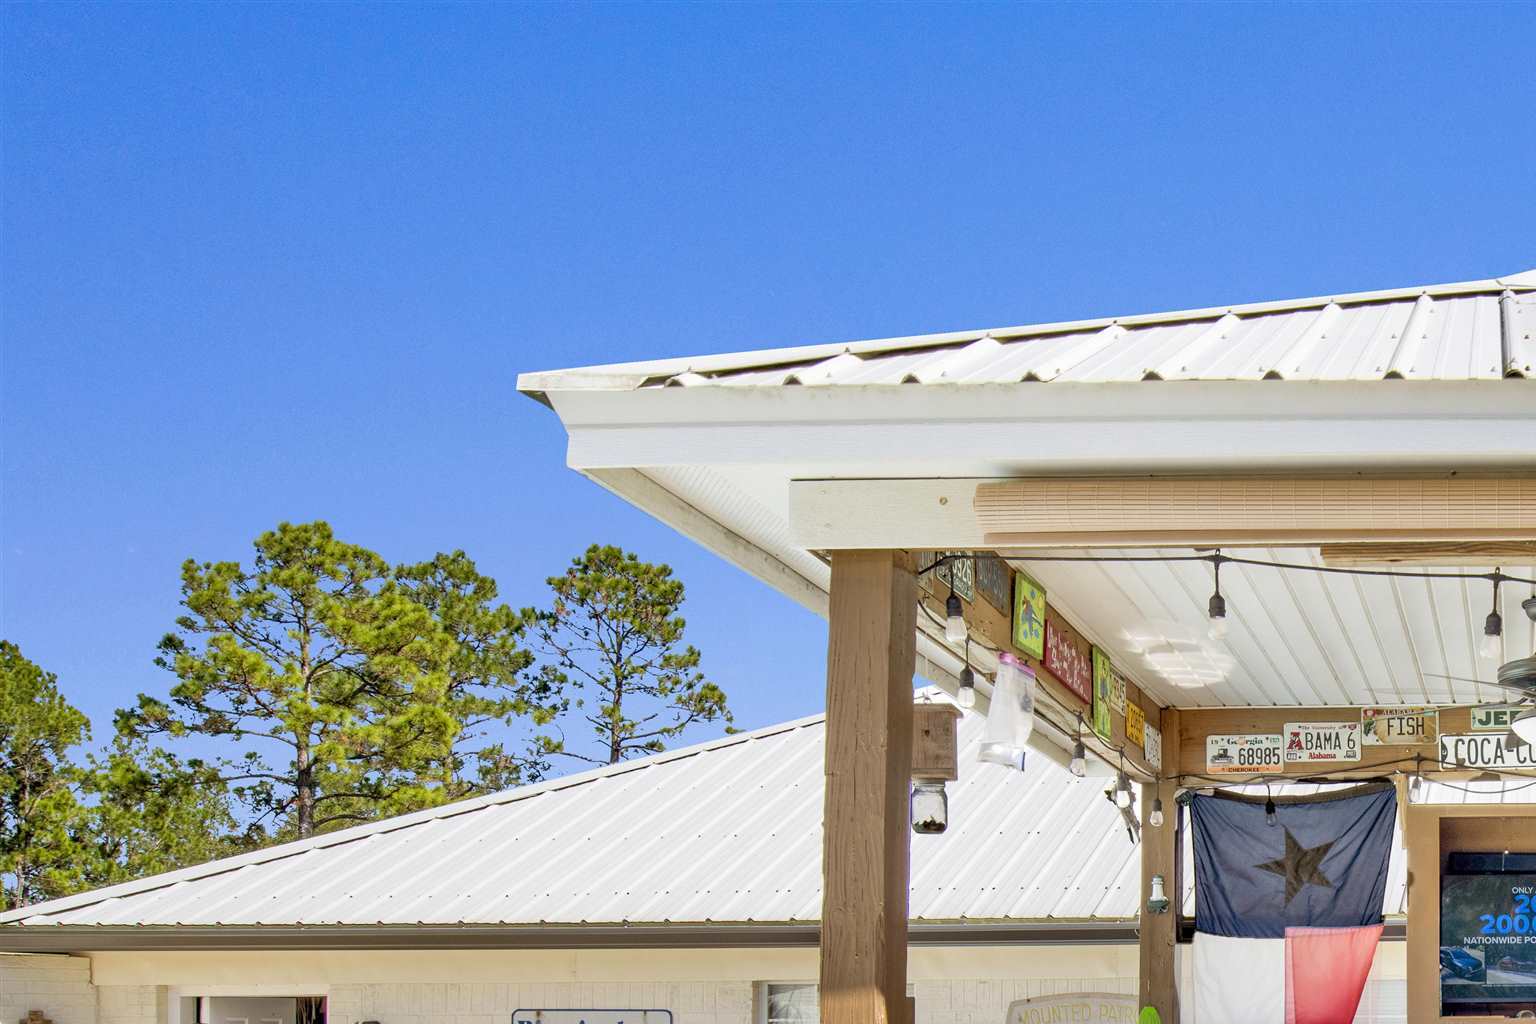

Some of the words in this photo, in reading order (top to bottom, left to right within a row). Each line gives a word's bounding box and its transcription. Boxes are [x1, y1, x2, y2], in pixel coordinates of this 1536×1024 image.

[1387, 716, 1425, 736] FISH
[1305, 731, 1342, 751] BAMA
[1347, 731, 1356, 750] 6
[1238, 746, 1281, 766] 68985
[1308, 751, 1337, 760] Alabama
[1511, 886, 1534, 895] ONLY
[1463, 936, 1523, 945] NATIONWIDE
